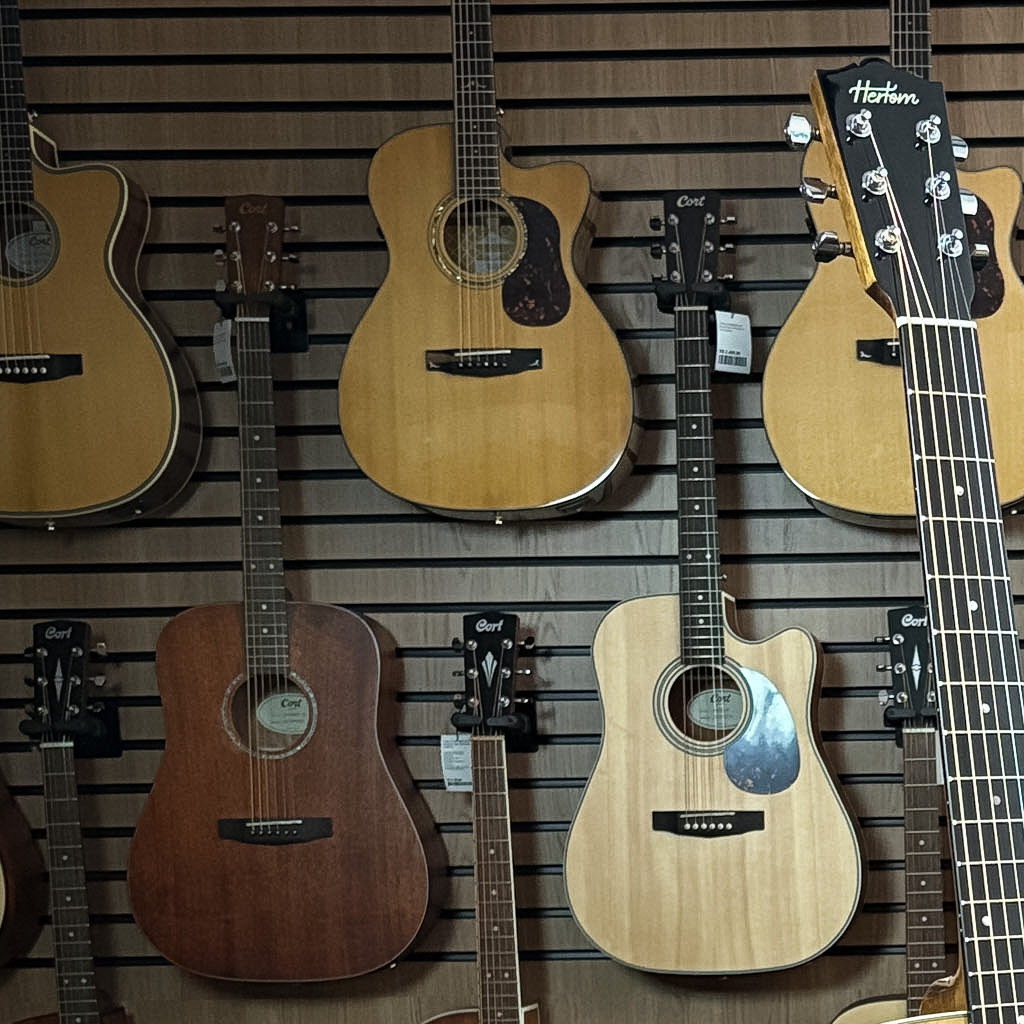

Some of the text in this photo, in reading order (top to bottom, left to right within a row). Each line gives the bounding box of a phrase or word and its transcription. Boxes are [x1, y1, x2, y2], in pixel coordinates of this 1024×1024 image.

[849, 80, 919, 105] Hertom
[677, 196, 705, 208] Cort
[476, 619, 503, 632] Cort
[901, 613, 928, 627] Cort
[45, 626, 72, 640] Cort
[280, 697, 302, 709] Cort
